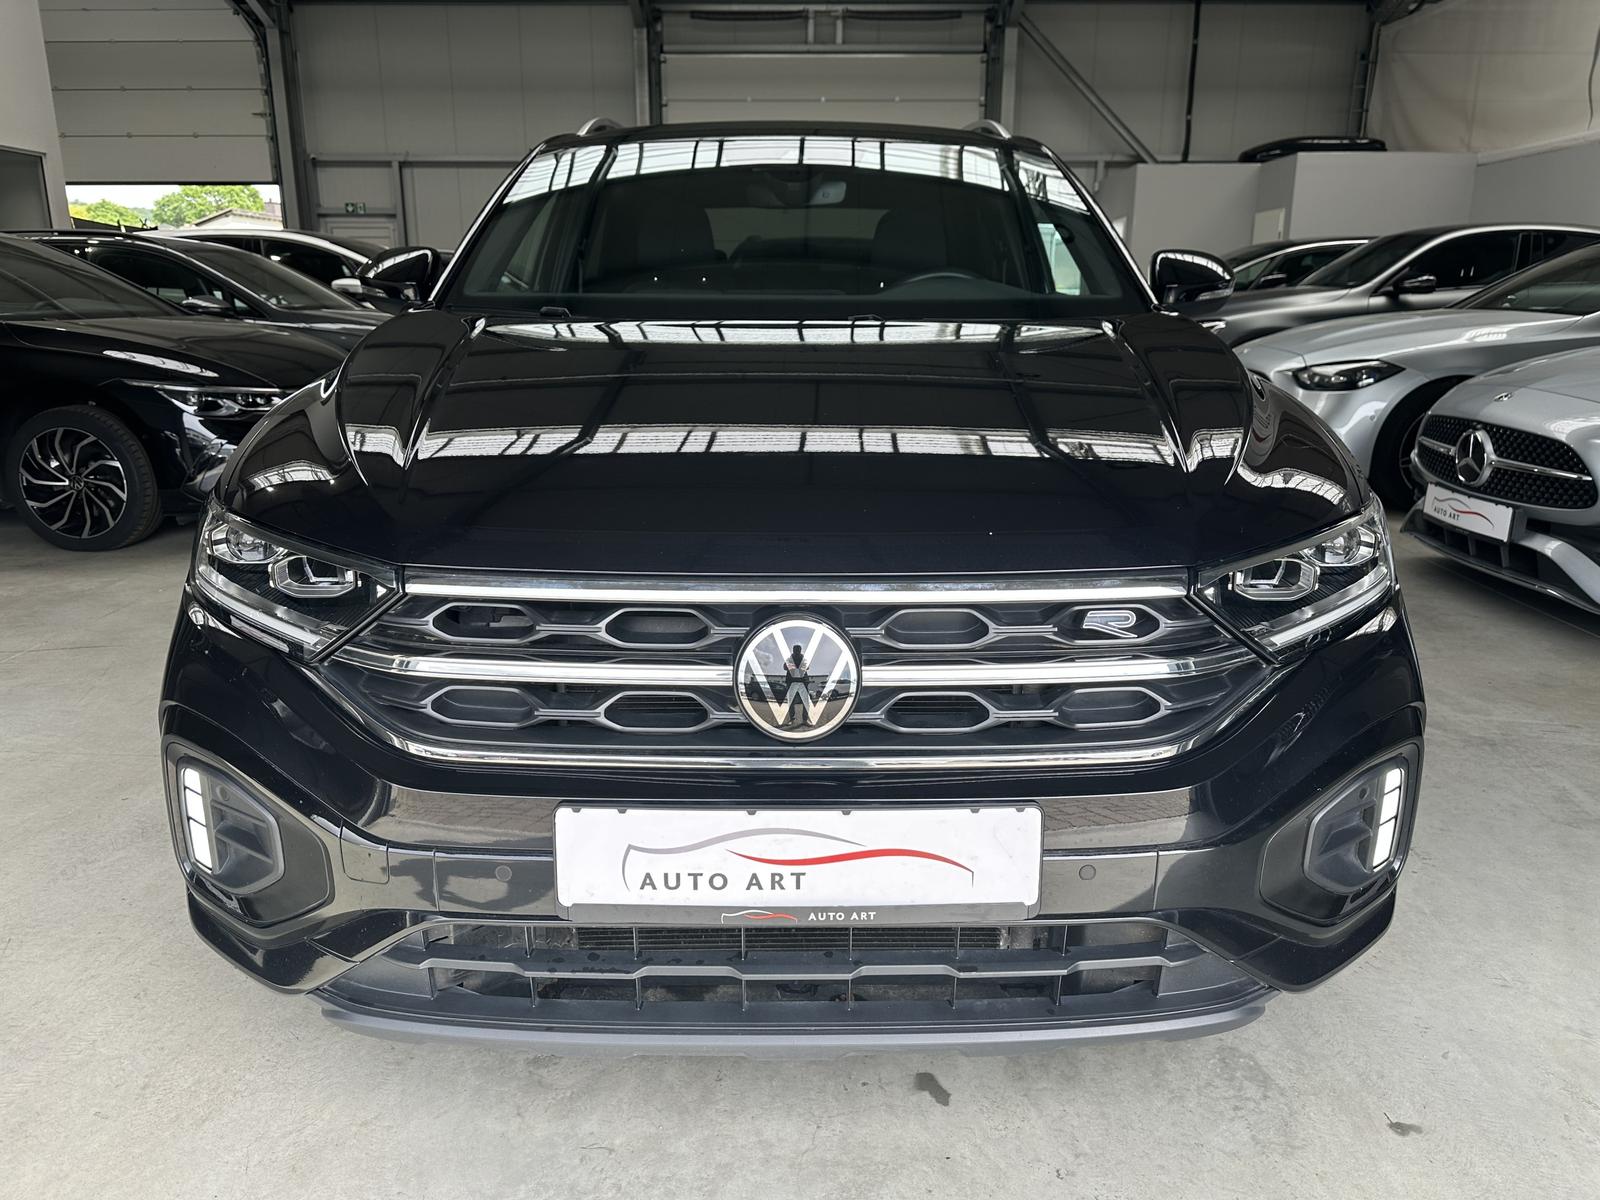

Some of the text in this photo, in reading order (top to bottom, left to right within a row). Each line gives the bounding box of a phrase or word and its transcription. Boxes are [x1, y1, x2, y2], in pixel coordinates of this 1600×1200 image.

[1433, 505, 1460, 521] AUTO ART
[639, 871, 807, 891] AUTO ART
[808, 911, 877, 921] AUTO ART
